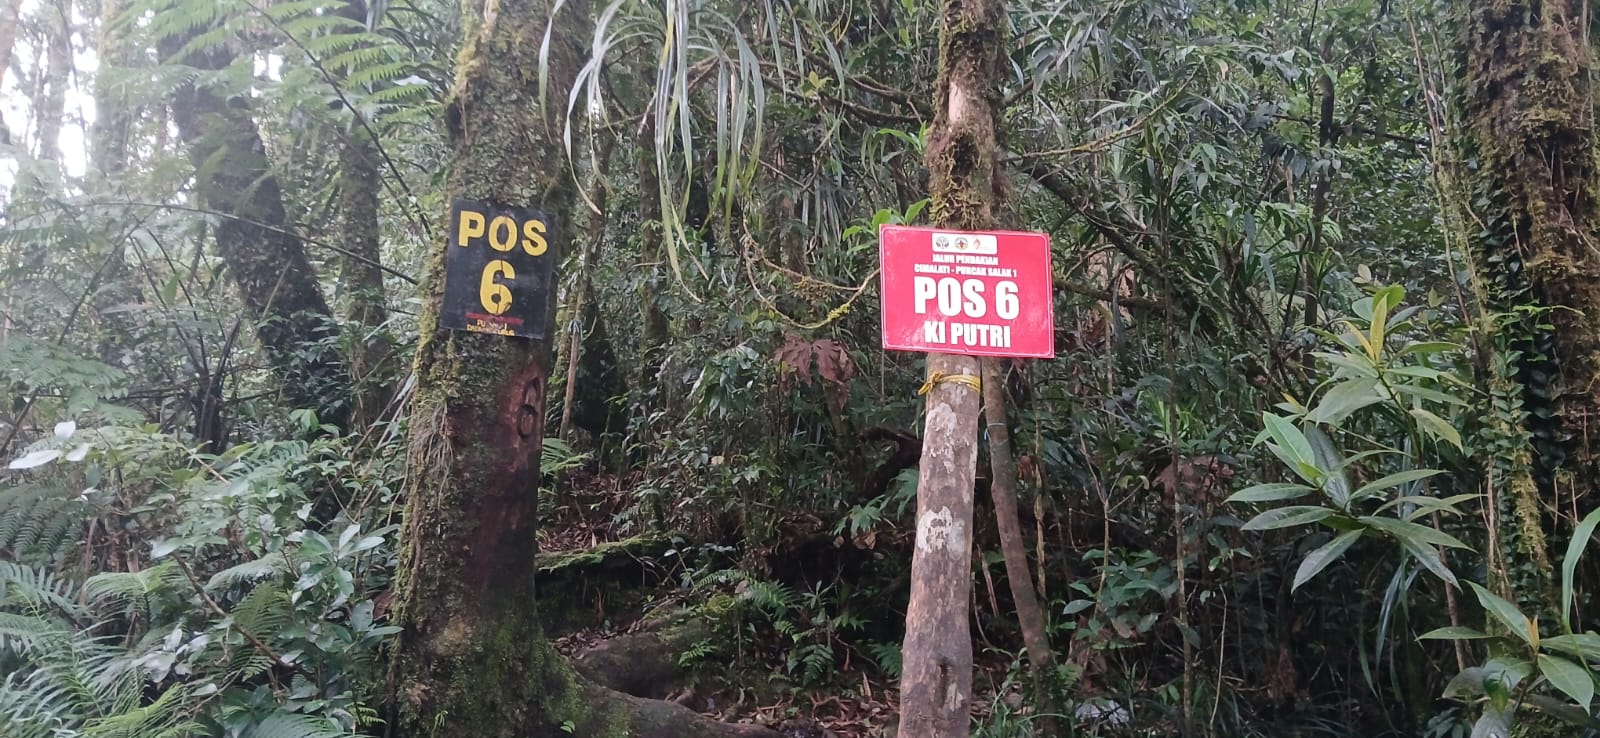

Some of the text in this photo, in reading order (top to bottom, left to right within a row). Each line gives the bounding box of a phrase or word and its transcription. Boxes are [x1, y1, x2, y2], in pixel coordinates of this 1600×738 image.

[458, 210, 548, 256] POS
[480, 259, 516, 315] 6
[956, 266, 987, 276] PUNCAK
[988, 268, 1011, 277] SALAK
[1012, 269, 1017, 277] 1
[914, 276, 1020, 320] POS 6
[924, 321, 1011, 347] KI PUTRI
